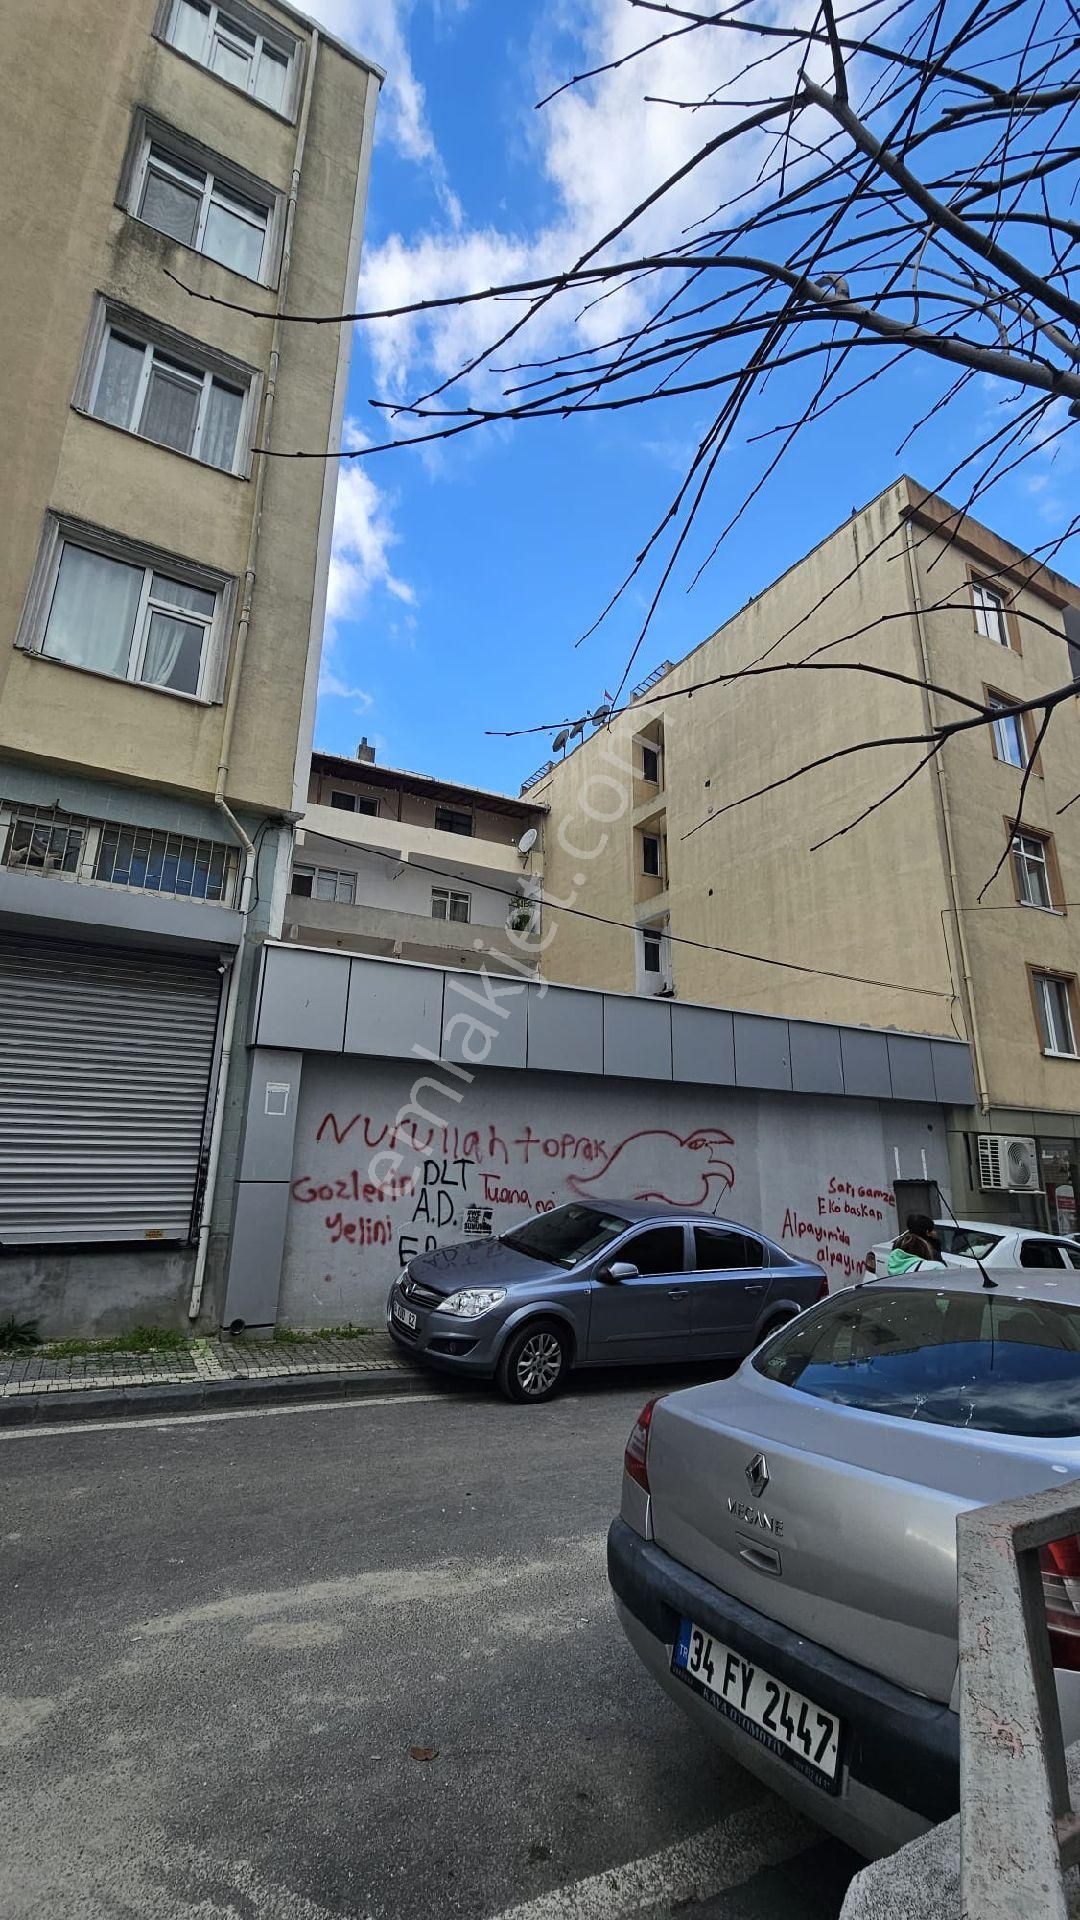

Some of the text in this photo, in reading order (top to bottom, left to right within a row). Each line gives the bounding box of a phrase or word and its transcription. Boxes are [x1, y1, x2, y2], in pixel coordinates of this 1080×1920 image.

[423, 1158, 475, 1191] DLT
[680, 1629, 834, 1764] TR 34 FY 2447
